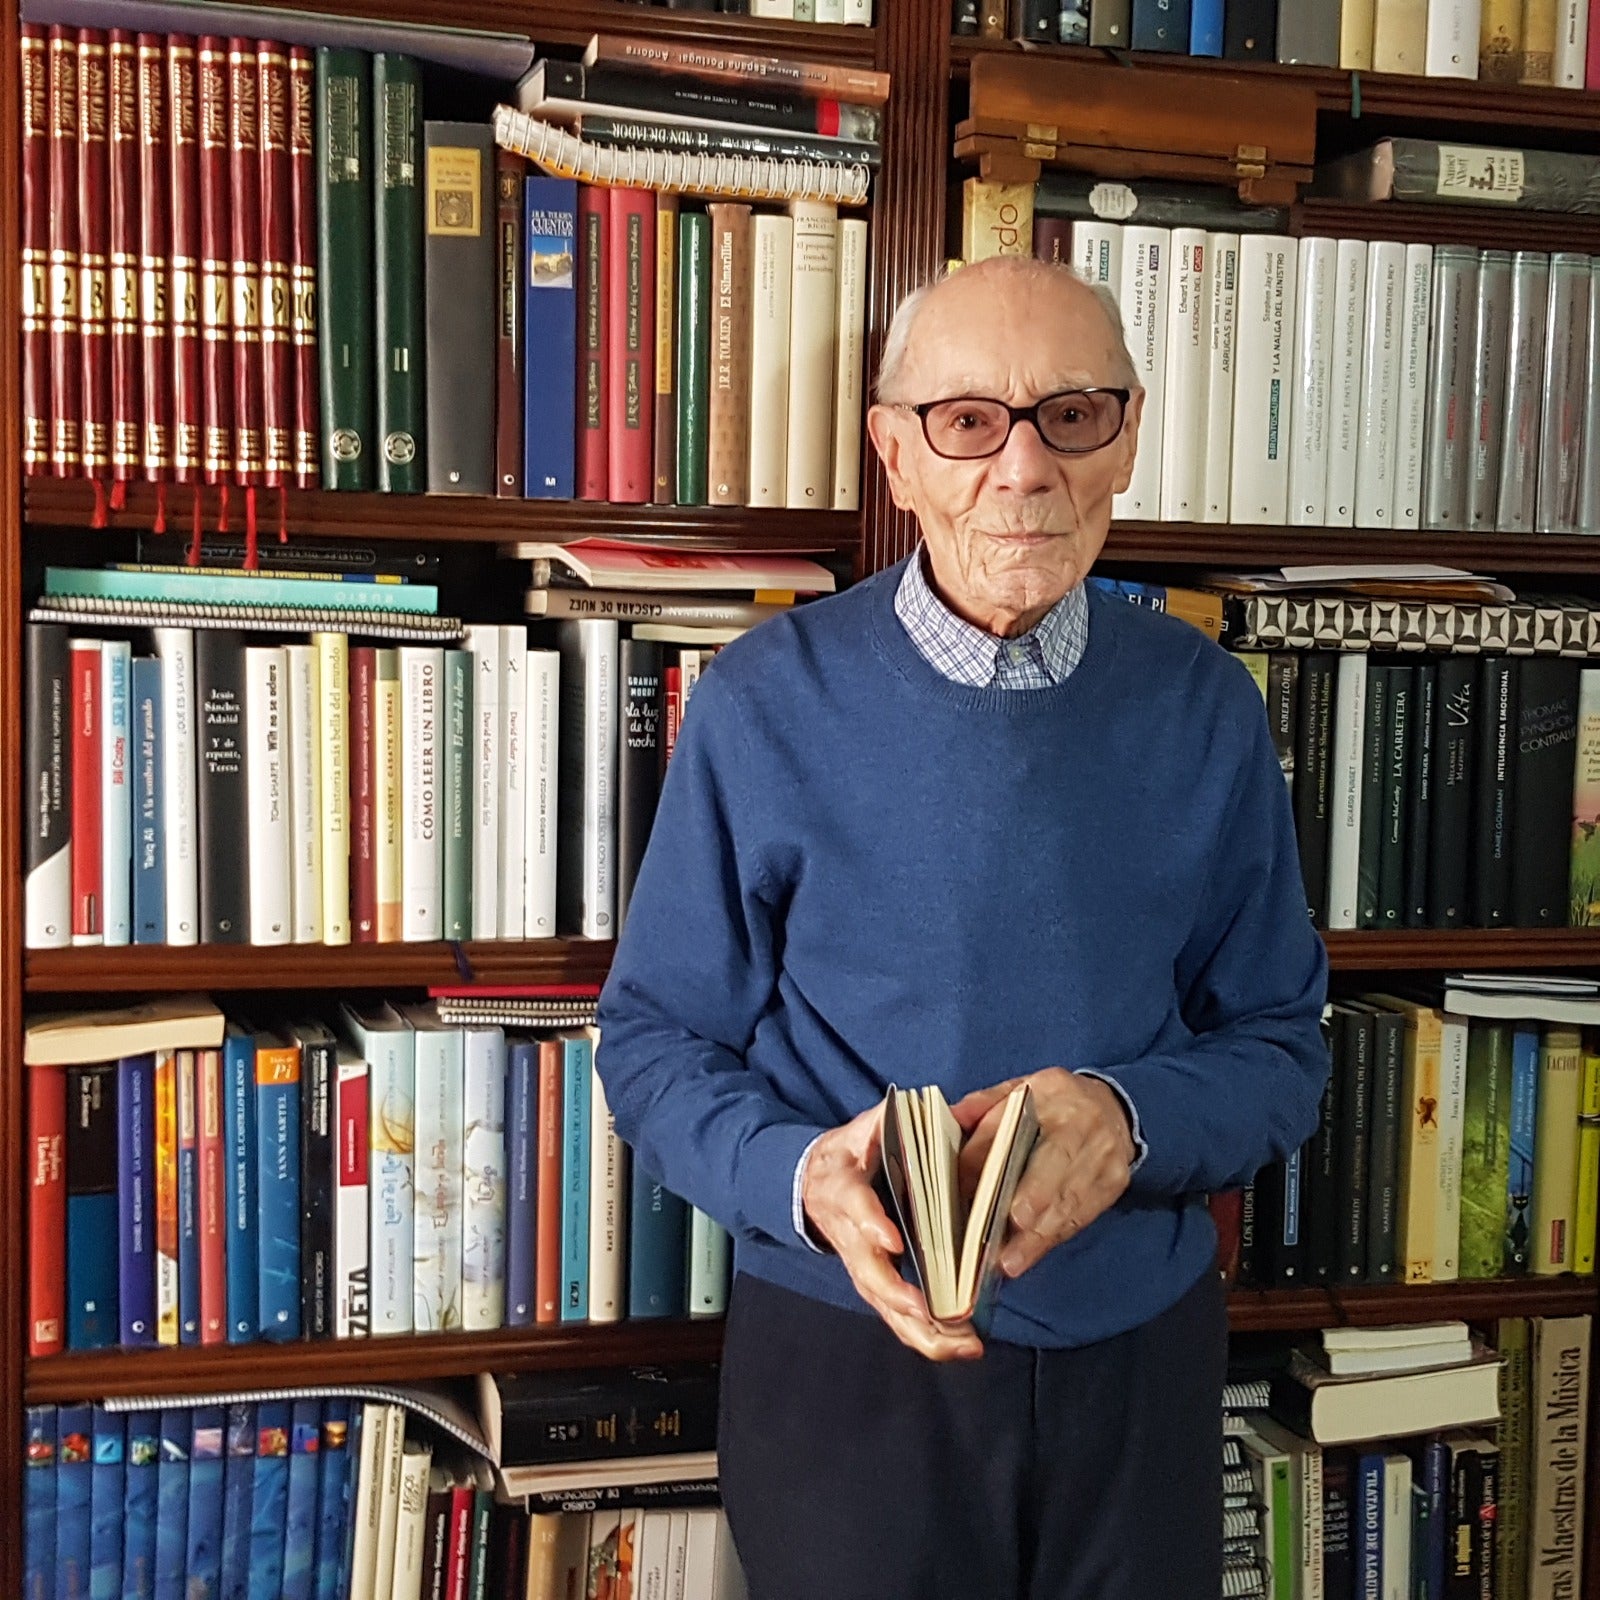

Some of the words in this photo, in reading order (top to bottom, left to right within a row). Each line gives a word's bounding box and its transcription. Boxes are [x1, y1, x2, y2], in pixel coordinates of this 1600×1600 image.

[625, 45, 668, 61] Andorra
[678, 52, 723, 68] Portugal
[728, 60, 767, 76] España
[589, 223, 599, 259] Perdidos
[630, 223, 640, 259] Perdidos
[720, 231, 732, 295] Silmarillion
[1100, 240, 1109, 280] JAGUAR
[1134, 243, 1145, 276] Wilson
[1149, 246, 1159, 270] VIDA
[1180, 245, 1190, 271] Lorenz
[1194, 246, 1203, 271] CAOS
[1226, 251, 1236, 289] TIEMPO
[1265, 252, 1274, 274] Gould
[589, 261, 599, 293] Cuentos
[630, 261, 640, 293] Cuentos
[1149, 274, 1158, 286] LA
[1194, 275, 1202, 292] DEL
[1264, 275, 1274, 289] Jay
[1275, 252, 1285, 297] MINISTRO
[1412, 262, 1421, 303] MINUTOS
[62, 277, 73, 305] 2
[93, 281, 104, 310] 3
[273, 287, 285, 314] 9
[720, 296, 732, 308] El
[1148, 289, 1157, 300] DE
[1179, 282, 1189, 313] Edward
[1225, 294, 1233, 306] EL
[1347, 295, 1355, 312] DEL
[589, 306, 598, 317] de
[629, 306, 638, 317] de
[1134, 288, 1143, 326] Edward
[1193, 293, 1201, 333] ESENCIA
[1224, 308, 1232, 322] EN
[1263, 290, 1274, 322] Stephen
[1274, 300, 1284, 319] DEL
[719, 315, 731, 360] TOLKIEN
[1147, 302, 1157, 357] DIVERSIDAD
[1192, 334, 1200, 345] LA
[1273, 319, 1282, 351] NALGA
[394, 347, 408, 371] II
[1222, 325, 1232, 372] ARRUGAS
[1272, 353, 1281, 366] LA
[1409, 348, 1418, 371] TRES
[588, 361, 598, 391] Tolkien
[628, 362, 637, 392] Tolkien
[719, 363, 731, 390] J.R.R.
[1146, 359, 1154, 371] LA
[1343, 363, 1352, 407] EINSTEIN
[1408, 371, 1417, 388] LOS
[1342, 413, 1350, 450] ALBERT
[599, 568, 612, 596] NUEZ
[601, 600, 613, 613] DE
[112, 656, 124, 699] PADRE
[266, 664, 277, 696] aclara
[329, 647, 340, 688] mundo
[628, 676, 659, 686] GRAHAM
[329, 692, 340, 711] del
[422, 664, 433, 713] LIBRO
[1320, 671, 1331, 707] Holmes
[1500, 670, 1510, 721] EMOCIONAL
[112, 703, 124, 727] SER
[268, 700, 277, 712] se
[1280, 698, 1291, 733] ROBERT
[1374, 680, 1383, 727] LONGITUD
[1446, 683, 1470, 727] Vita
[143, 699, 156, 740] granado
[207, 713, 238, 724] Adalid
[267, 714, 277, 728] no
[329, 713, 341, 741] bella
[422, 719, 433, 742] UN
[483, 711, 492, 736] David
[510, 711, 518, 736] David
[630, 718, 642, 732] de
[1309, 703, 1317, 735] CONAN
[1318, 707, 1330, 746] Sherlock
[1394, 691, 1407, 760] CARRETERA
[112, 737, 125, 768] Cosby
[143, 741, 154, 757] del
[212, 737, 220, 748] Y
[265, 730, 278, 752] Wilt
[628, 733, 656, 748] noche
[1319, 747, 1327, 759] de
[1497, 723, 1507, 781] INTELIGENCIA
[112, 769, 123, 785] Bill
[143, 759, 154, 796] sombra
[208, 762, 239, 772] Teresa
[422, 747, 433, 786] LEER
[1393, 762, 1403, 778] LA
[143, 797, 153, 809] la
[330, 771, 342, 815] historia
[143, 810, 153, 819] A
[269, 799, 279, 822] TOM
[420, 789, 433, 840] CÓMO
[1346, 796, 1355, 828] EDUARDO
[331, 818, 342, 832] La
[539, 816, 547, 855] EDUARDO
[598, 844, 607, 894] SANTIAGO
[1448, 1098, 1460, 1121] Juan
[1242, 1225, 1253, 1247] LOS
[349, 1266, 369, 1338] ZETA
[1543, 1348, 1580, 1421] Música
[1548, 1424, 1578, 1443] la
[1548, 1447, 1577, 1471] de
[1365, 1469, 1378, 1529] TRATADO
[1540, 1475, 1576, 1567] Maestras
[1365, 1532, 1378, 1551] DE
